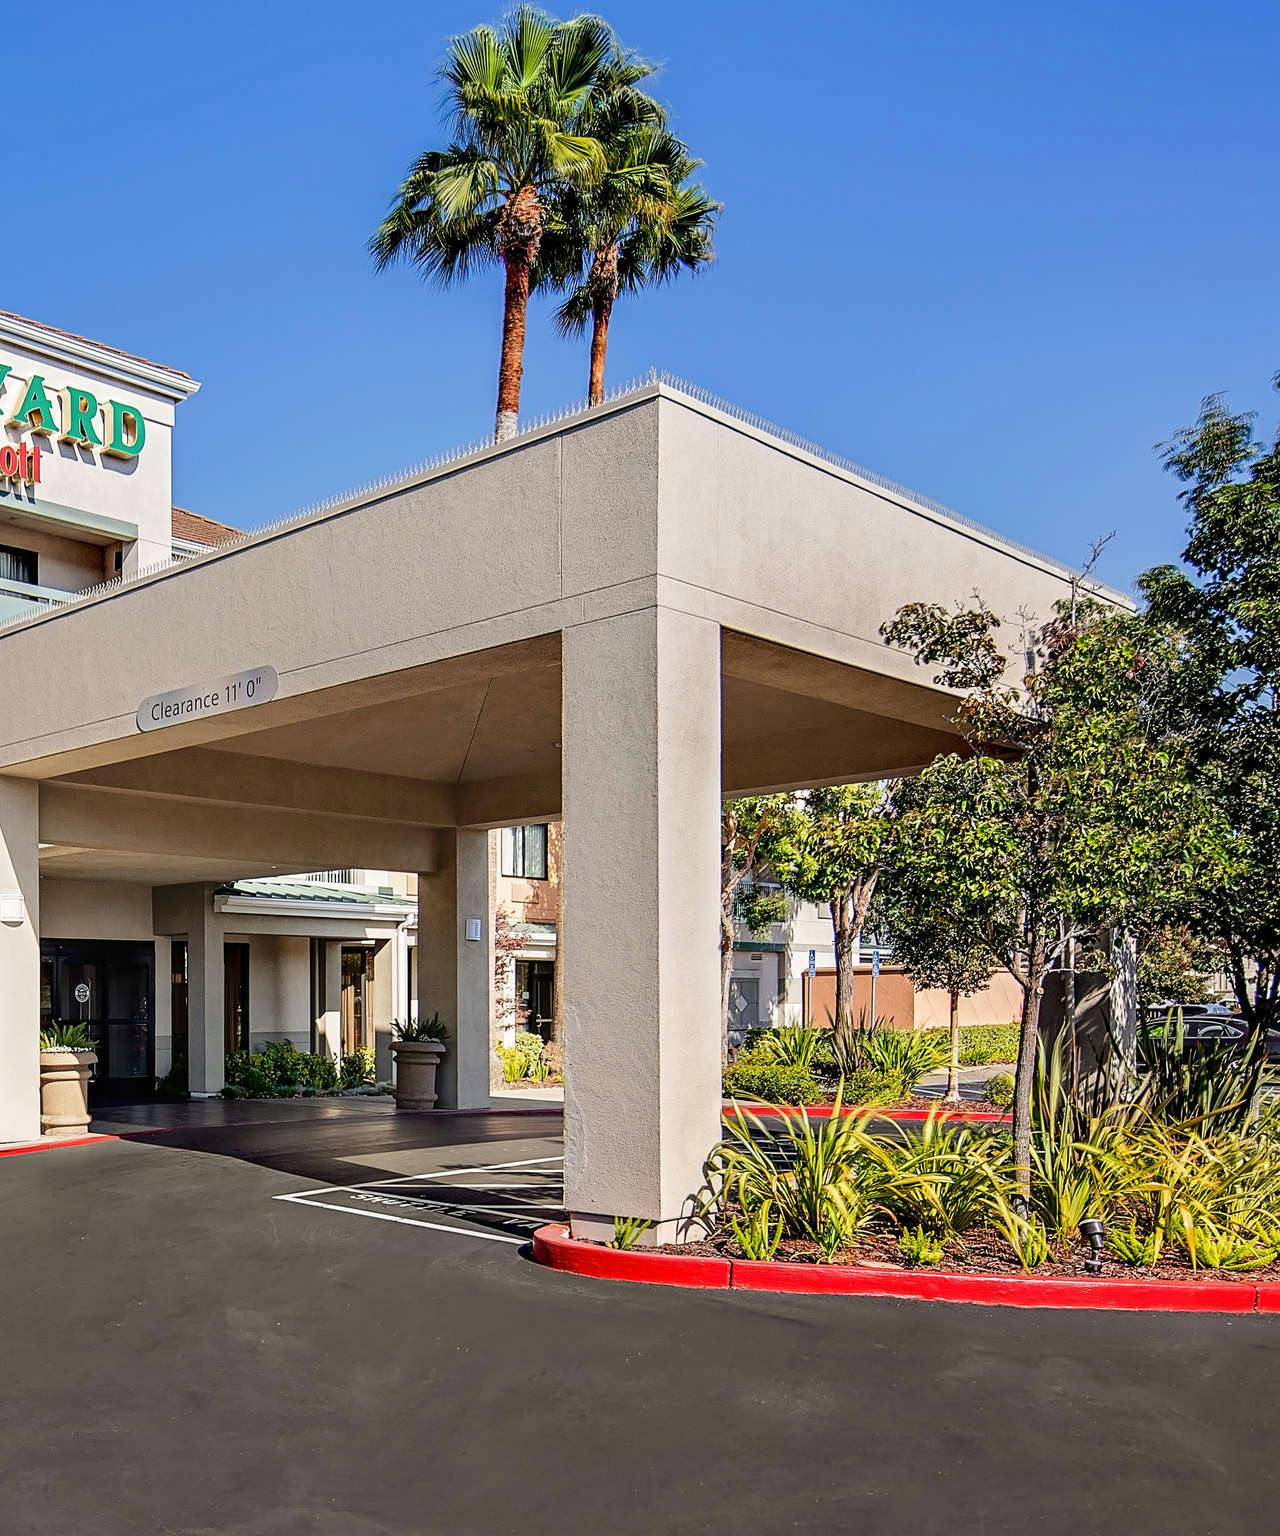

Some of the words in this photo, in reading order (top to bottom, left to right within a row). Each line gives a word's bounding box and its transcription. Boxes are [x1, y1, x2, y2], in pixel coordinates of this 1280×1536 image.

[151, 693, 219, 721] Clearance
[225, 682, 241, 703] 11'
[246, 677, 262, 698] 0"
[350, 1193, 477, 1217] SHUTTLE
